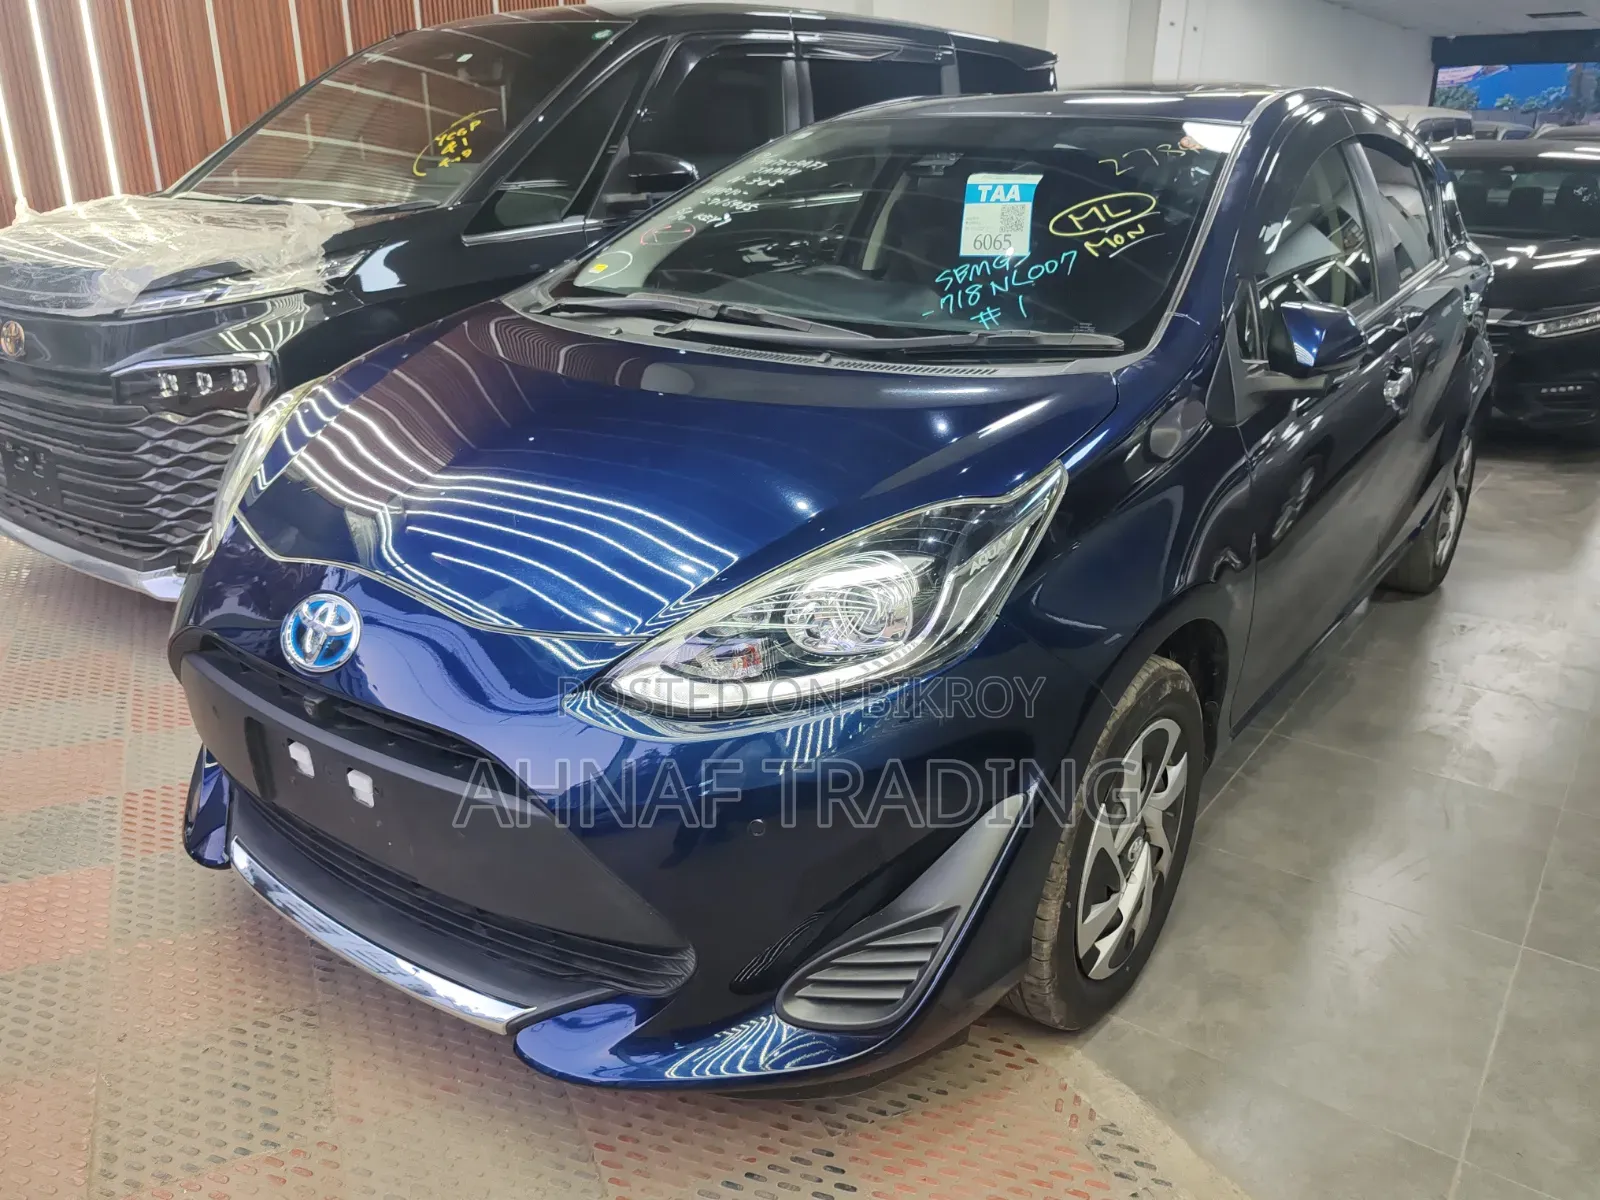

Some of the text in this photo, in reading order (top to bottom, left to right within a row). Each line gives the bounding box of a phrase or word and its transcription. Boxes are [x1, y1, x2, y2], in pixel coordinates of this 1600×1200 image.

[977, 184, 1021, 202] TAA
[1068, 203, 1132, 231] ML
[973, 233, 1013, 251] 6065
[1084, 224, 1145, 257] MON
[969, 538, 1010, 576] AQUA
